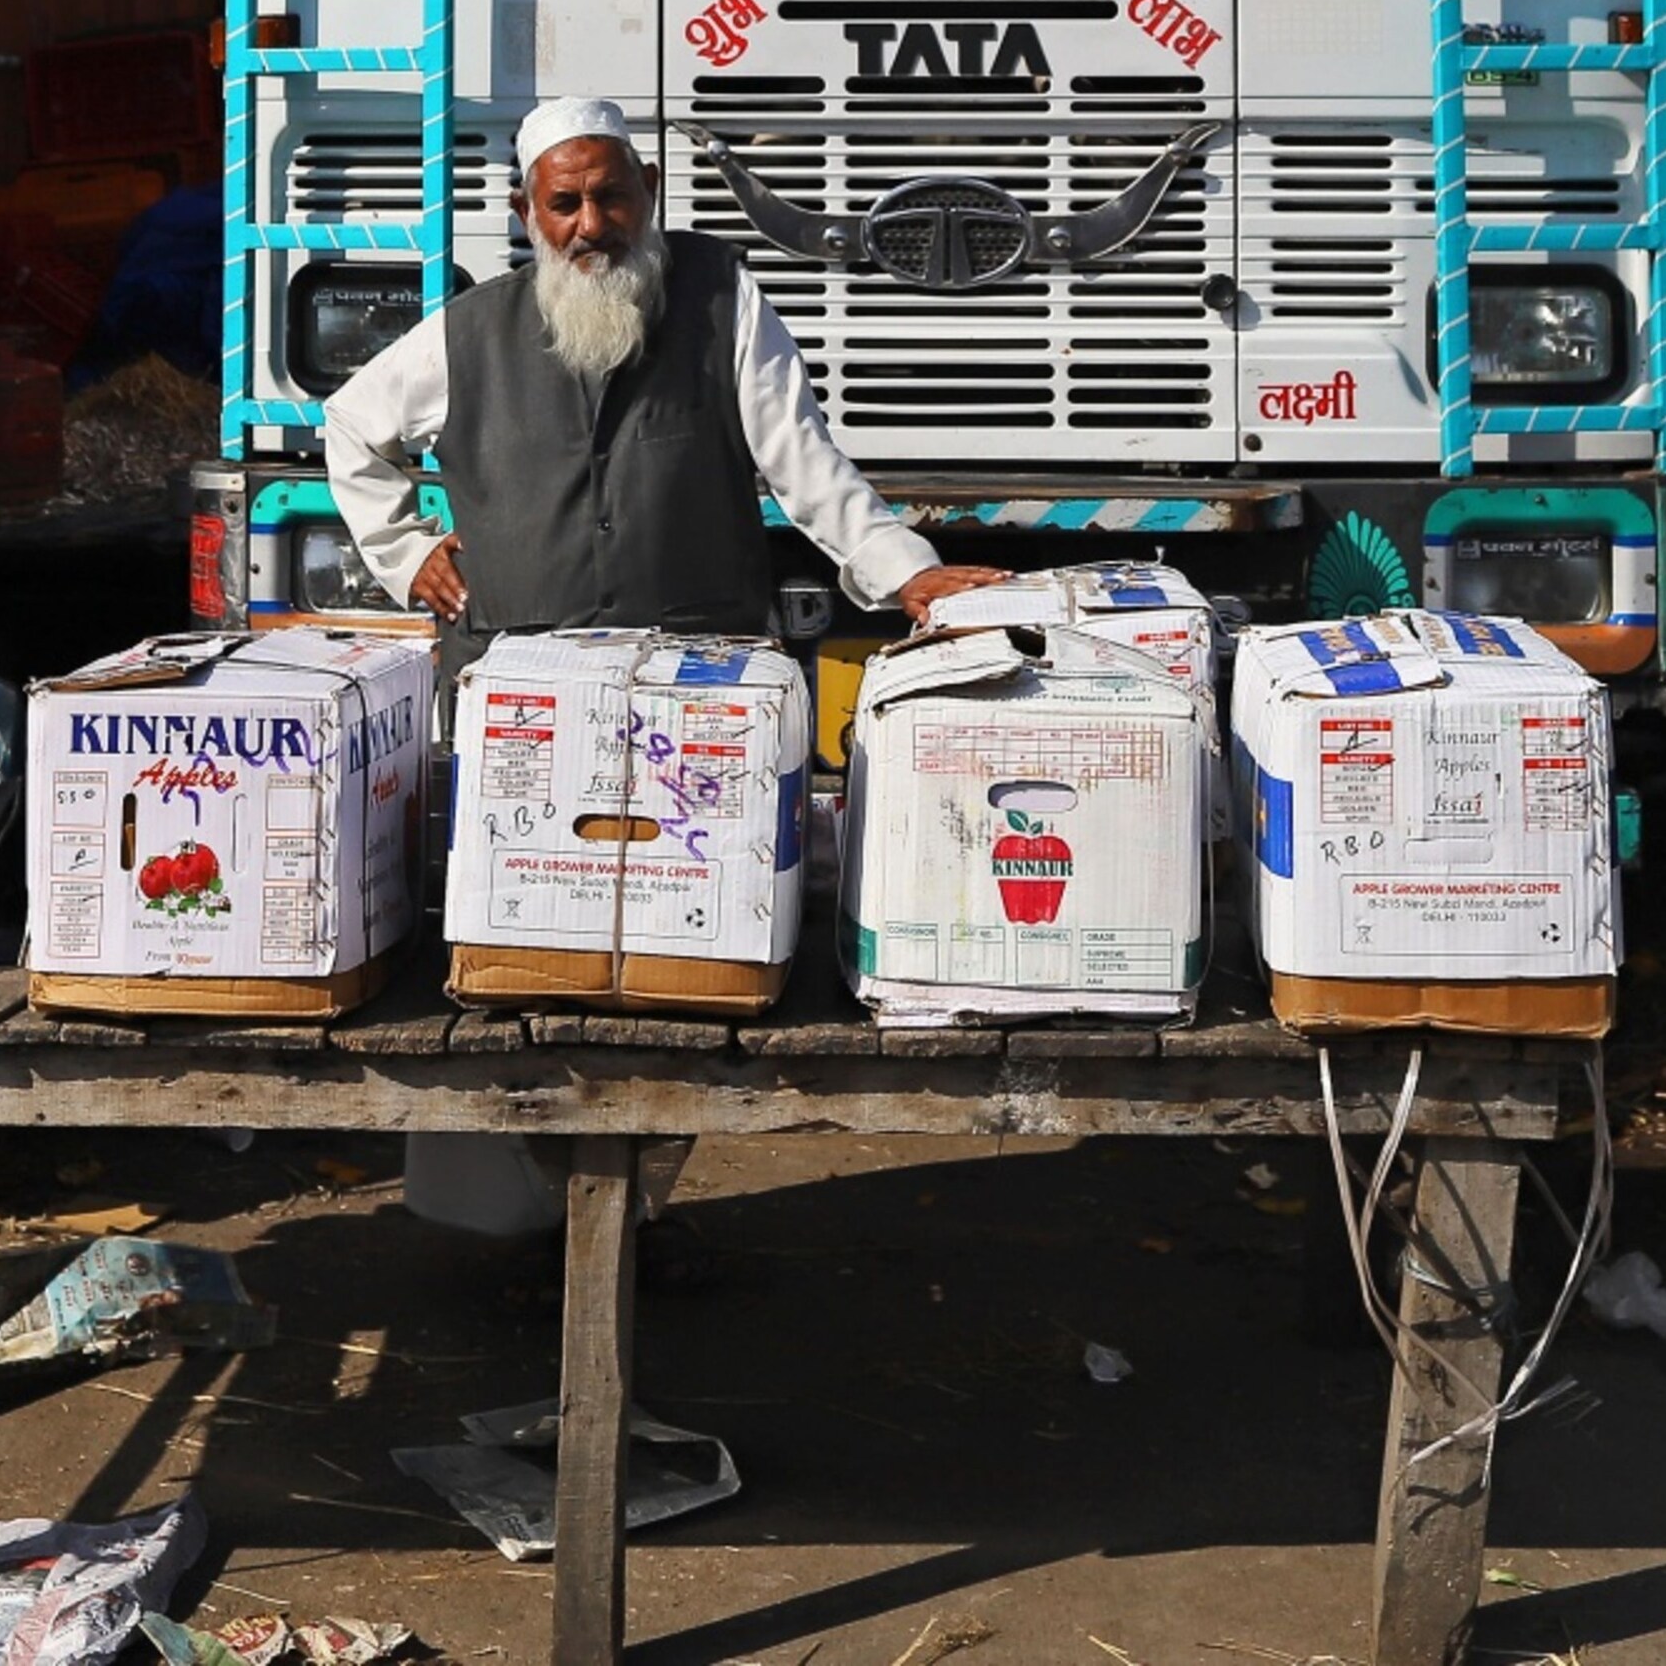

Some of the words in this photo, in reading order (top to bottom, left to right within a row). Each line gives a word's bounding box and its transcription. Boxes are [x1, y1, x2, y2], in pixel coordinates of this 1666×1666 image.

[843, 22, 1053, 78] TATA
[1257, 369, 1358, 426] लक्ष्मी
[69, 712, 305, 758] KINNAUR
[1427, 726, 1498, 745] Kinnaur
[132, 756, 240, 797] Apples
[1434, 754, 1490, 782] Apples
[504, 857, 539, 870] APPLE
[542, 859, 594, 874] GROWER
[667, 866, 709, 880] CENTRE
[991, 858, 1074, 877] KINNAUR
[569, 888, 603, 901] DELHI
[1352, 882, 1388, 895] APPLE
[1391, 882, 1444, 895] GROWER
[1447, 882, 1517, 895] MARKETING
[1519, 882, 1562, 895] CENTRE
[1403, 898, 1428, 909] New
[1422, 912, 1456, 923] DELHI
[1086, 932, 1116, 942] GRADE
